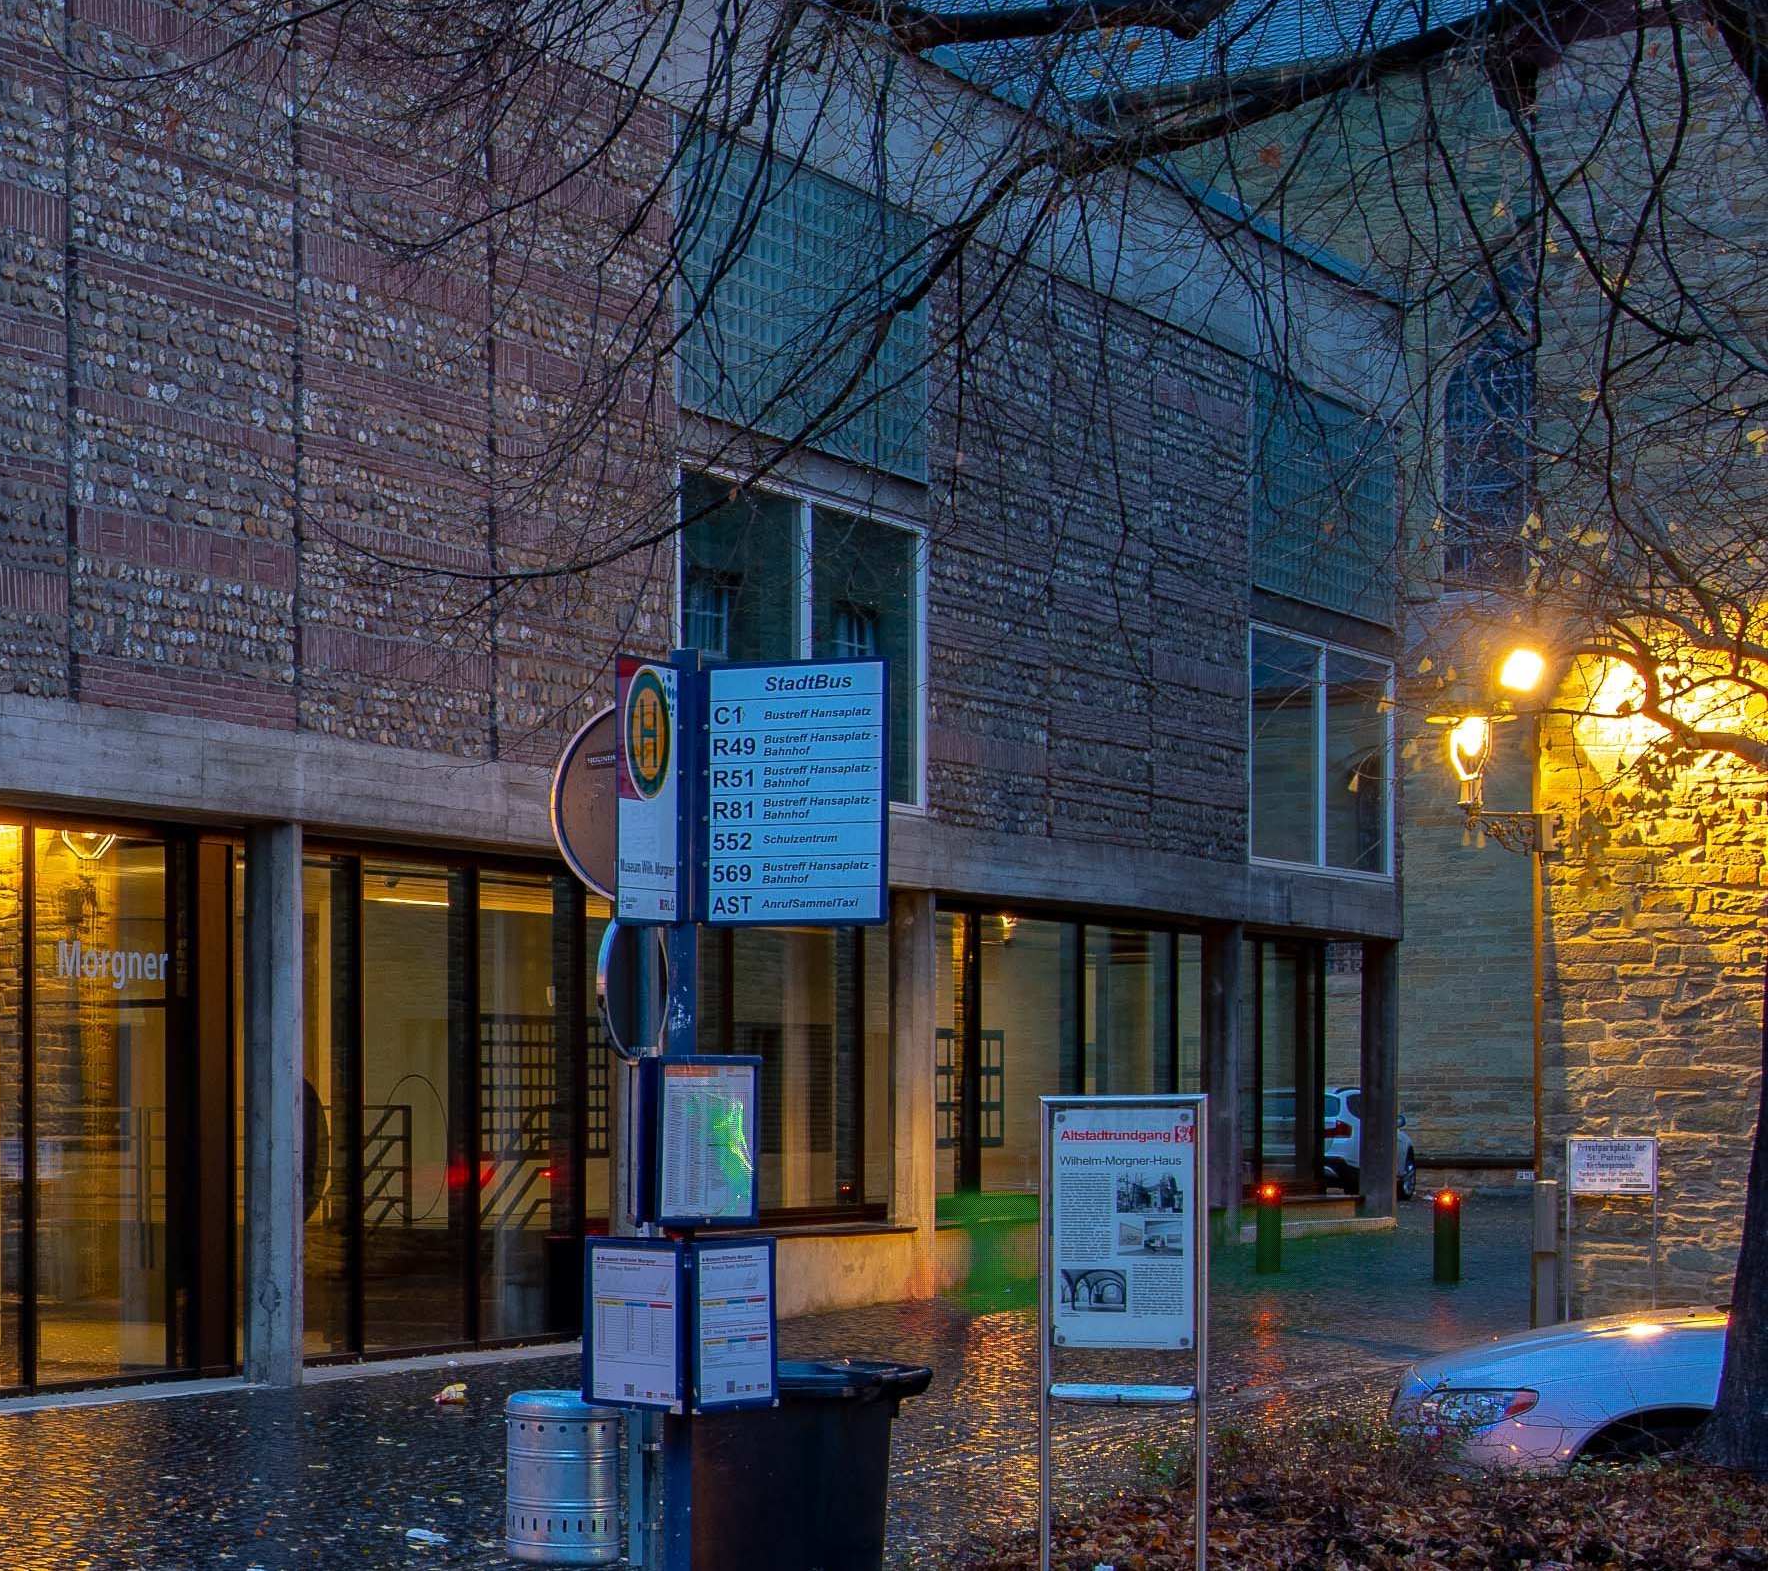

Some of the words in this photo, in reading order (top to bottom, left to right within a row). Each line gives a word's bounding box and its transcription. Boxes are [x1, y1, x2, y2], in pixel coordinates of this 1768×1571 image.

[765, 673, 852, 692] StadtBus
[714, 706, 743, 724] C1
[764, 709, 808, 720] Bustreff
[810, 707, 872, 719] Hansaplatz
[764, 733, 808, 744] Bustreff
[810, 731, 871, 743] Hansaplatz
[713, 737, 756, 756] R49
[764, 745, 811, 757] Bahnhof
[764, 765, 808, 776] Bustreff
[810, 763, 871, 776] Hansaplatz
[713, 768, 754, 788] R51
[764, 777, 811, 788] Bahnhof
[763, 797, 808, 808] Bustreff
[810, 795, 870, 807] Hansaplatz
[713, 801, 753, 820] R81
[763, 809, 810, 820] Bahnhof
[713, 832, 752, 851] 552
[763, 833, 838, 844] Schulzentrum
[620, 858, 641, 874] Museum
[762, 862, 807, 872] Bustreff
[809, 860, 870, 872] Hansaplatz
[713, 864, 752, 883] 569
[762, 874, 810, 884] Bahnhof
[713, 896, 752, 914] AST
[762, 898, 859, 909] AnrufSammelTaxi
[58, 940, 168, 989] Morgner
[1061, 1130, 1171, 1142] Altstadtrundgang
[1634, 1143, 1647, 1151] der
[1059, 1155, 1182, 1168] Wilhelm-Morgner-Haus
